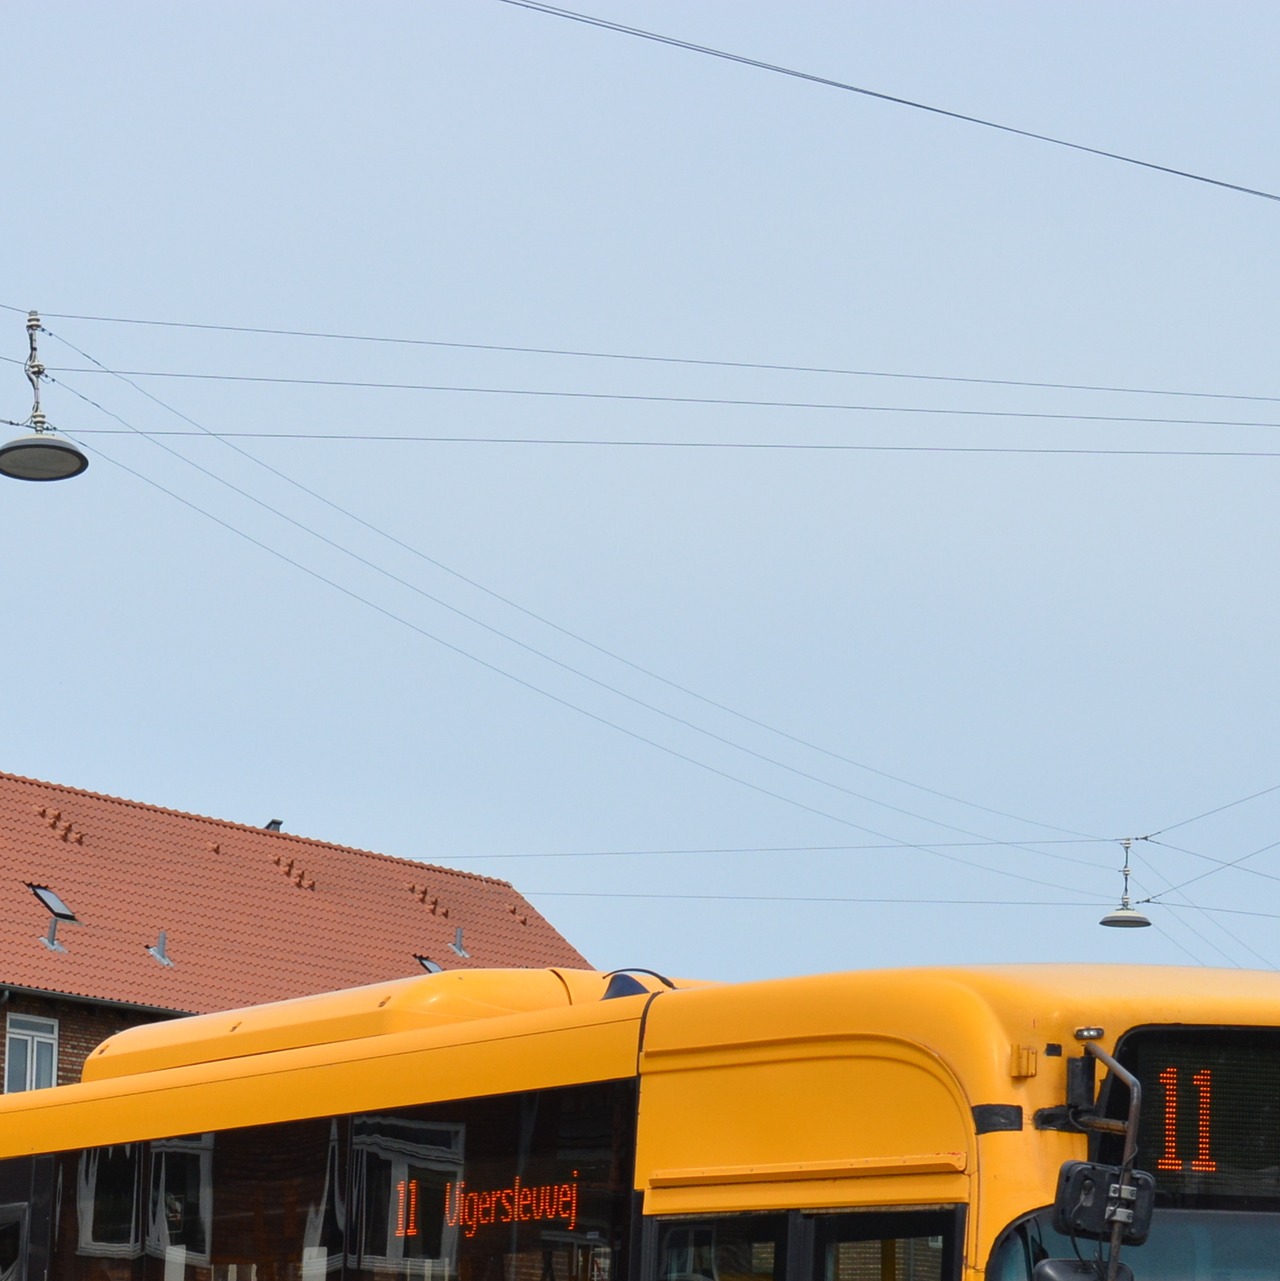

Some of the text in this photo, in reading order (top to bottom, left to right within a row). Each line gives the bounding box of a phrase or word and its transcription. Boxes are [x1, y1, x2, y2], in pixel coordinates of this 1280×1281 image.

[1158, 1067, 1216, 1172] 11
[395, 1170, 579, 1237] 11 Vigerslevvej
